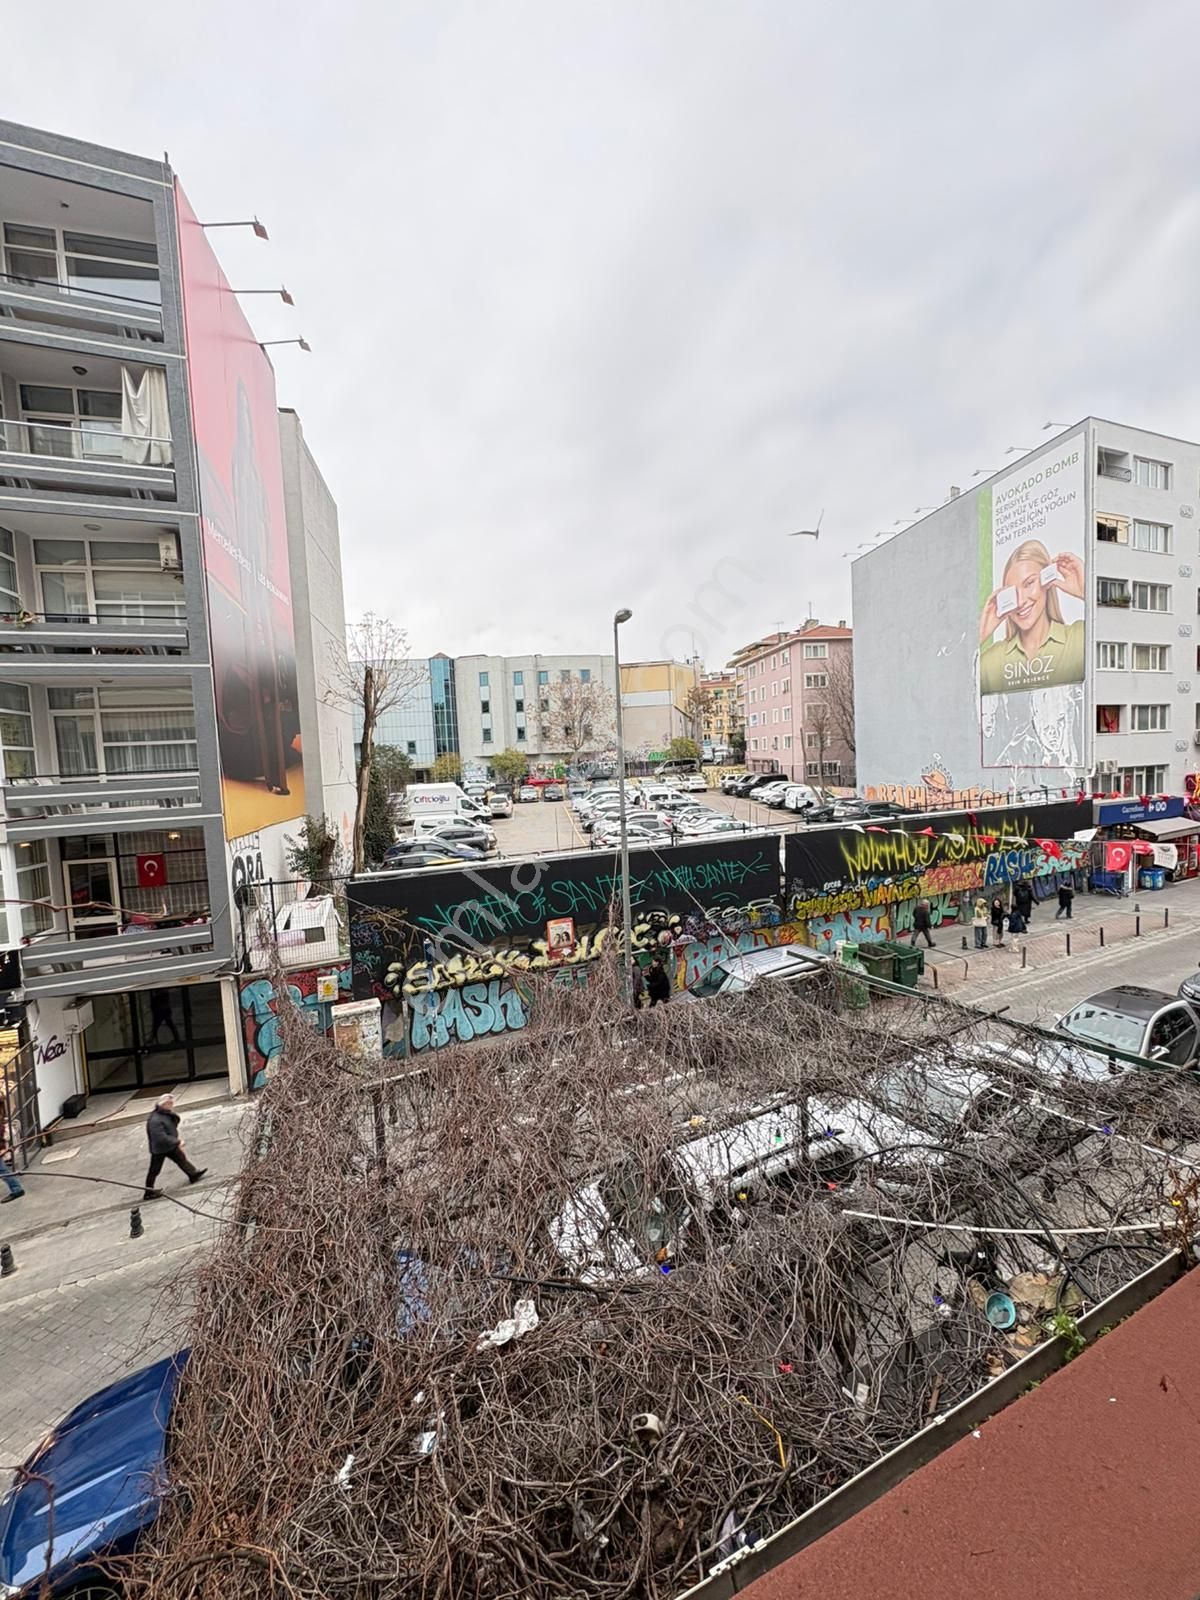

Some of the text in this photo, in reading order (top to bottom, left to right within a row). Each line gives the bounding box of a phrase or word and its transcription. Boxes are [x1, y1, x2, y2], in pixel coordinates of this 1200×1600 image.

[995, 451, 1080, 506] AVOKADO BOMB
[1028, 496, 1039, 510] VE
